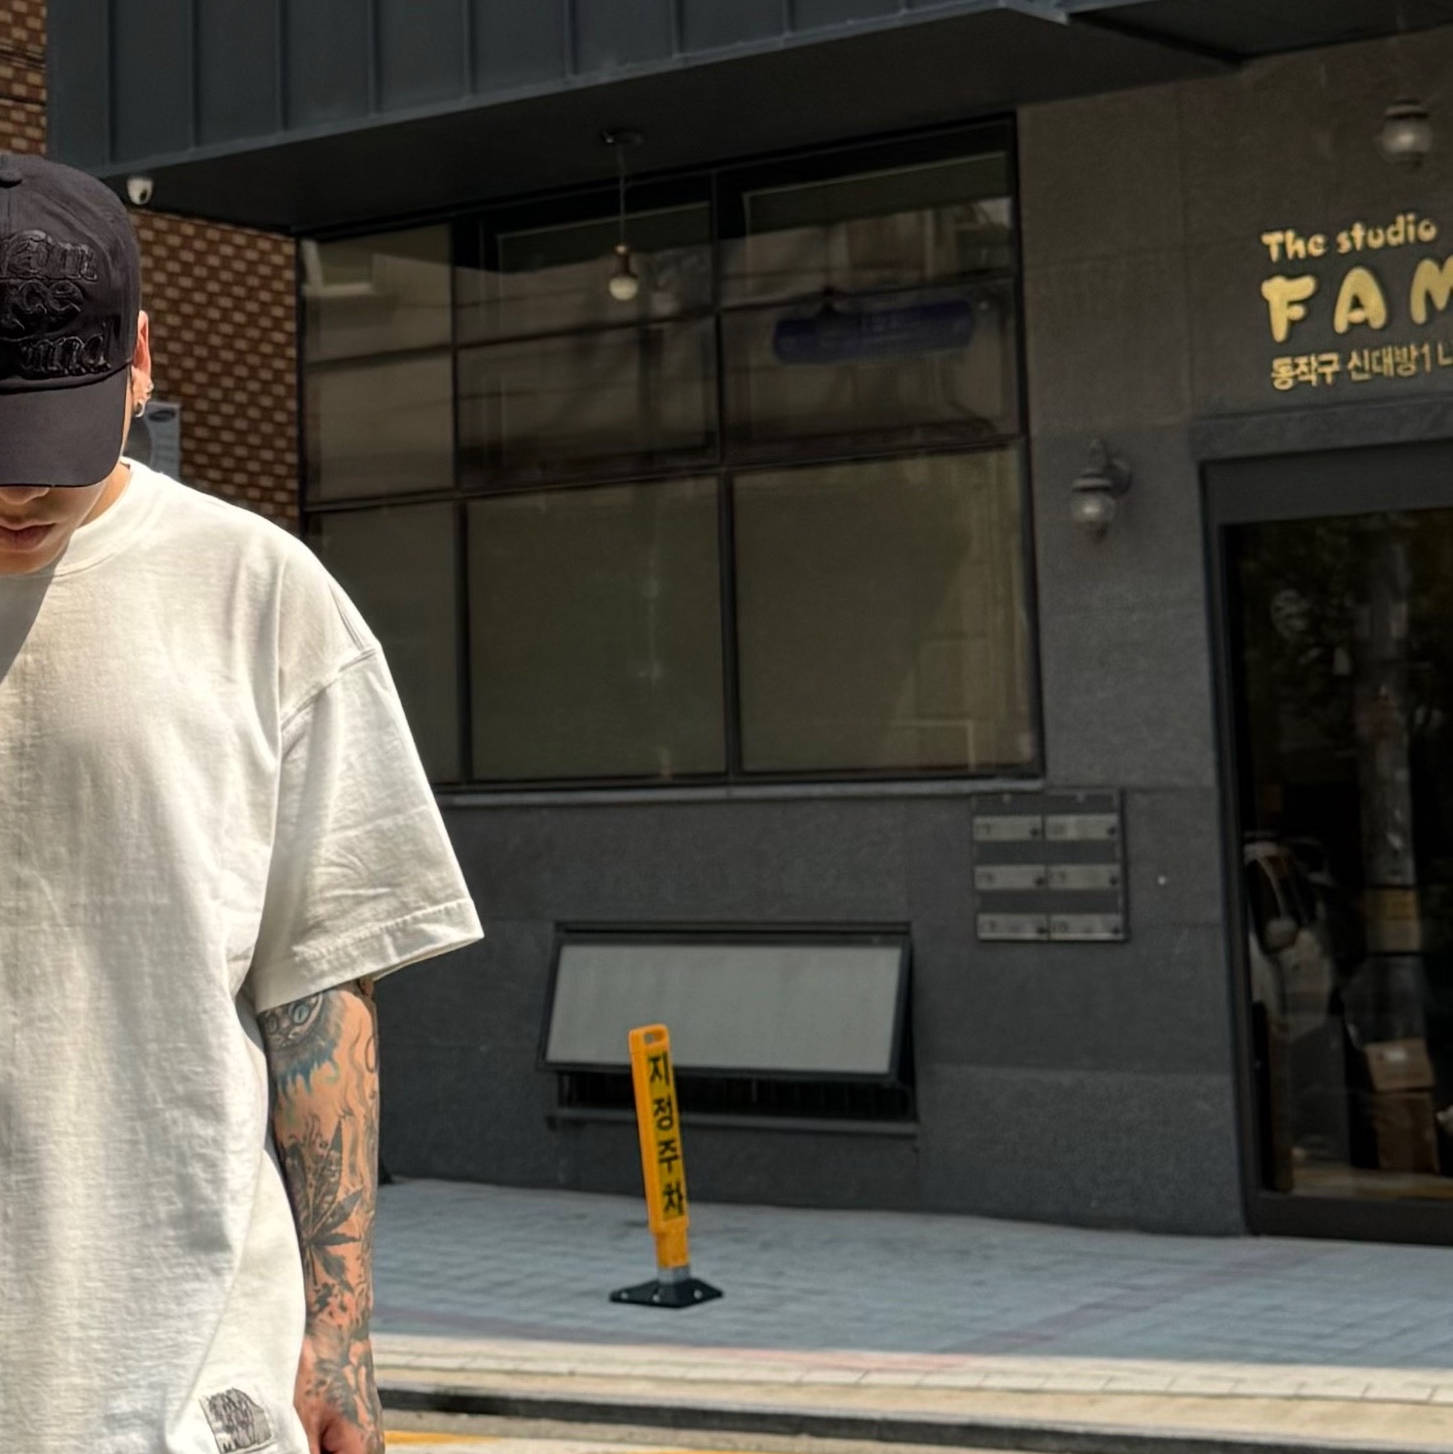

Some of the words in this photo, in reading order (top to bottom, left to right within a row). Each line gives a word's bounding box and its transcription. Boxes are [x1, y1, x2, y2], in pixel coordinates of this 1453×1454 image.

[1261, 229, 1328, 263] The
[1336, 212, 1437, 254] studio
[1271, 351, 1340, 391] 동작구
[647, 1052, 684, 1216] 지정주차
